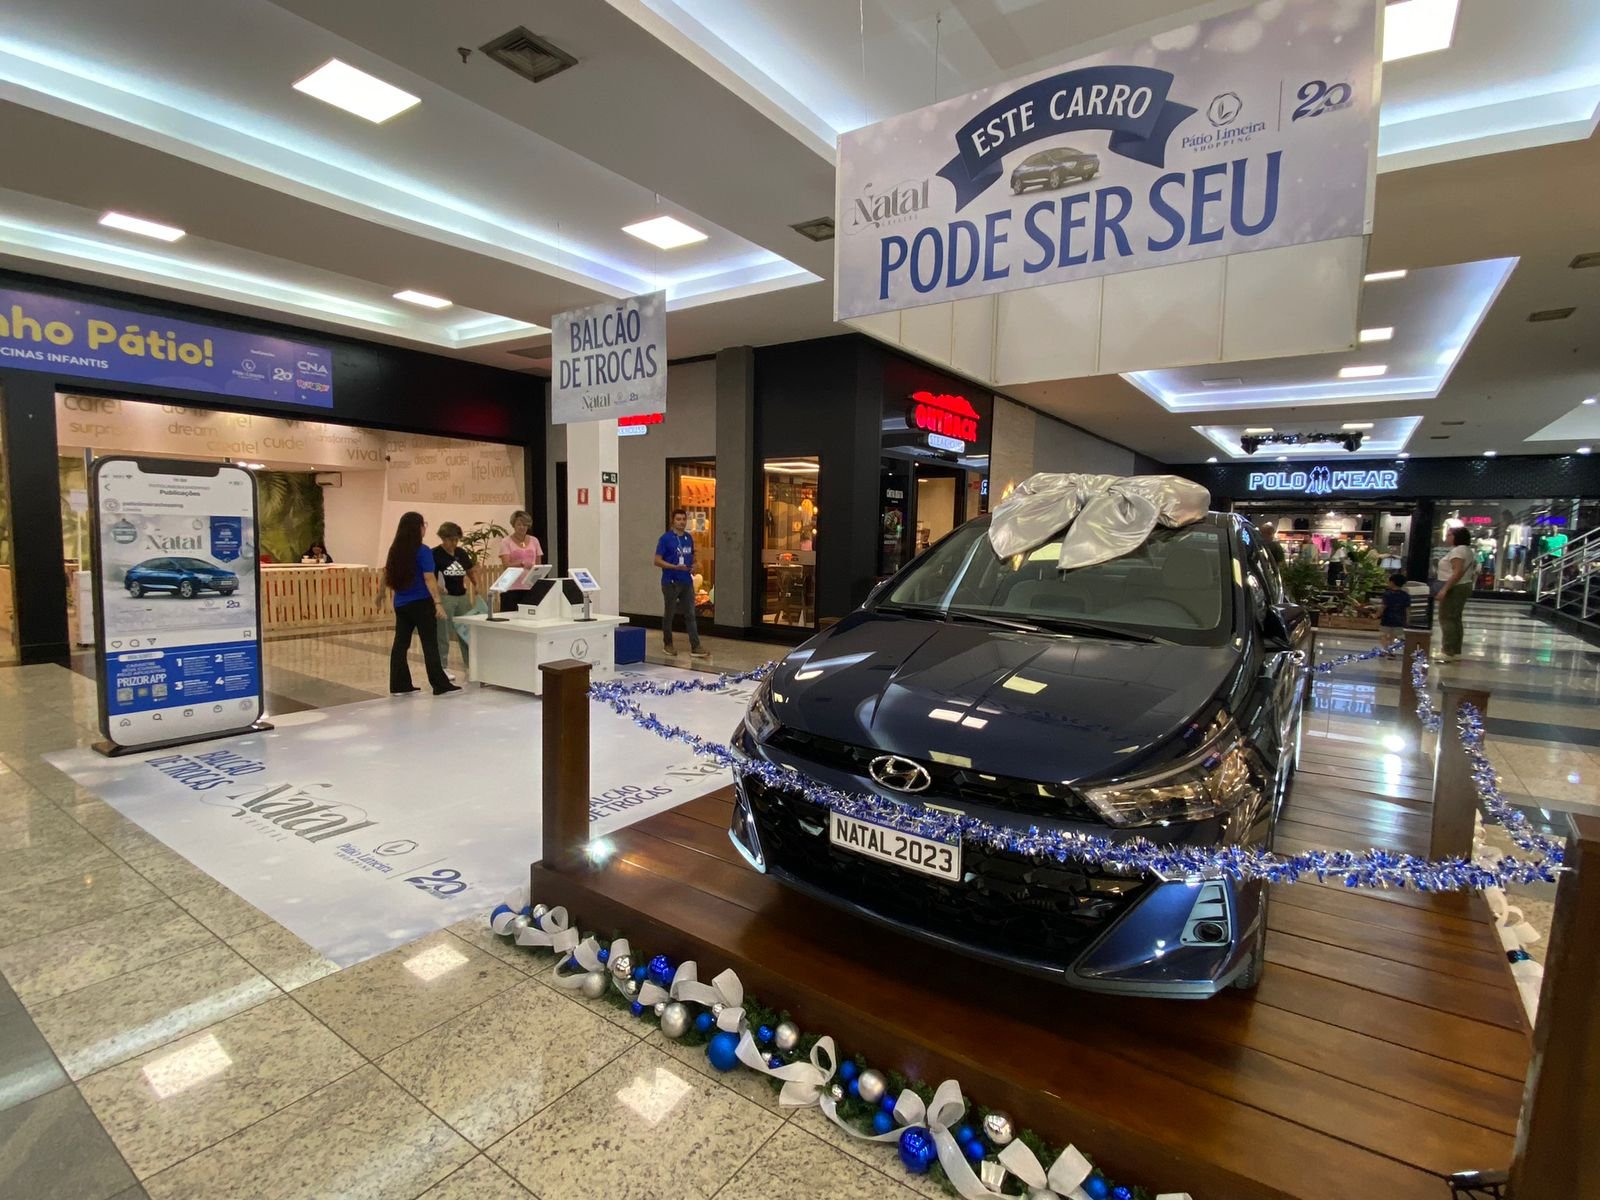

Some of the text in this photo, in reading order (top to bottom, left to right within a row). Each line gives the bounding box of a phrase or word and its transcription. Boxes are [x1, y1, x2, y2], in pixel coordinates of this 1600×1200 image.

[971, 84, 1153, 158] ESTE CARRO
[1181, 121, 1266, 149] Pátio Limeira
[1193, 136, 1252, 152] SHOPPING
[852, 178, 930, 228] Natal
[879, 150, 1283, 300] PODE SER SEU
[0, 305, 214, 367] ho Pátio!
[570, 307, 641, 353] BALCÃO
[48, 353, 109, 369] INFANTIS
[298, 361, 328, 374] CNA
[560, 344, 657, 390] DE TROCAS
[582, 390, 611, 412] Natal
[914, 404, 977, 442] OUTBACK
[1249, 471, 1398, 490] POLO WEAR
[146, 531, 203, 553] Natal
[176, 658, 183, 667] 1
[215, 654, 223, 662] 2
[150, 673, 167, 684] APP
[174, 681, 183, 690] 3
[215, 677, 224, 685] 4
[589, 785, 641, 810] ALCÃO
[602, 786, 673, 816] TROCAS
[226, 783, 379, 843] Natal
[836, 817, 953, 873] NATAL 2023
